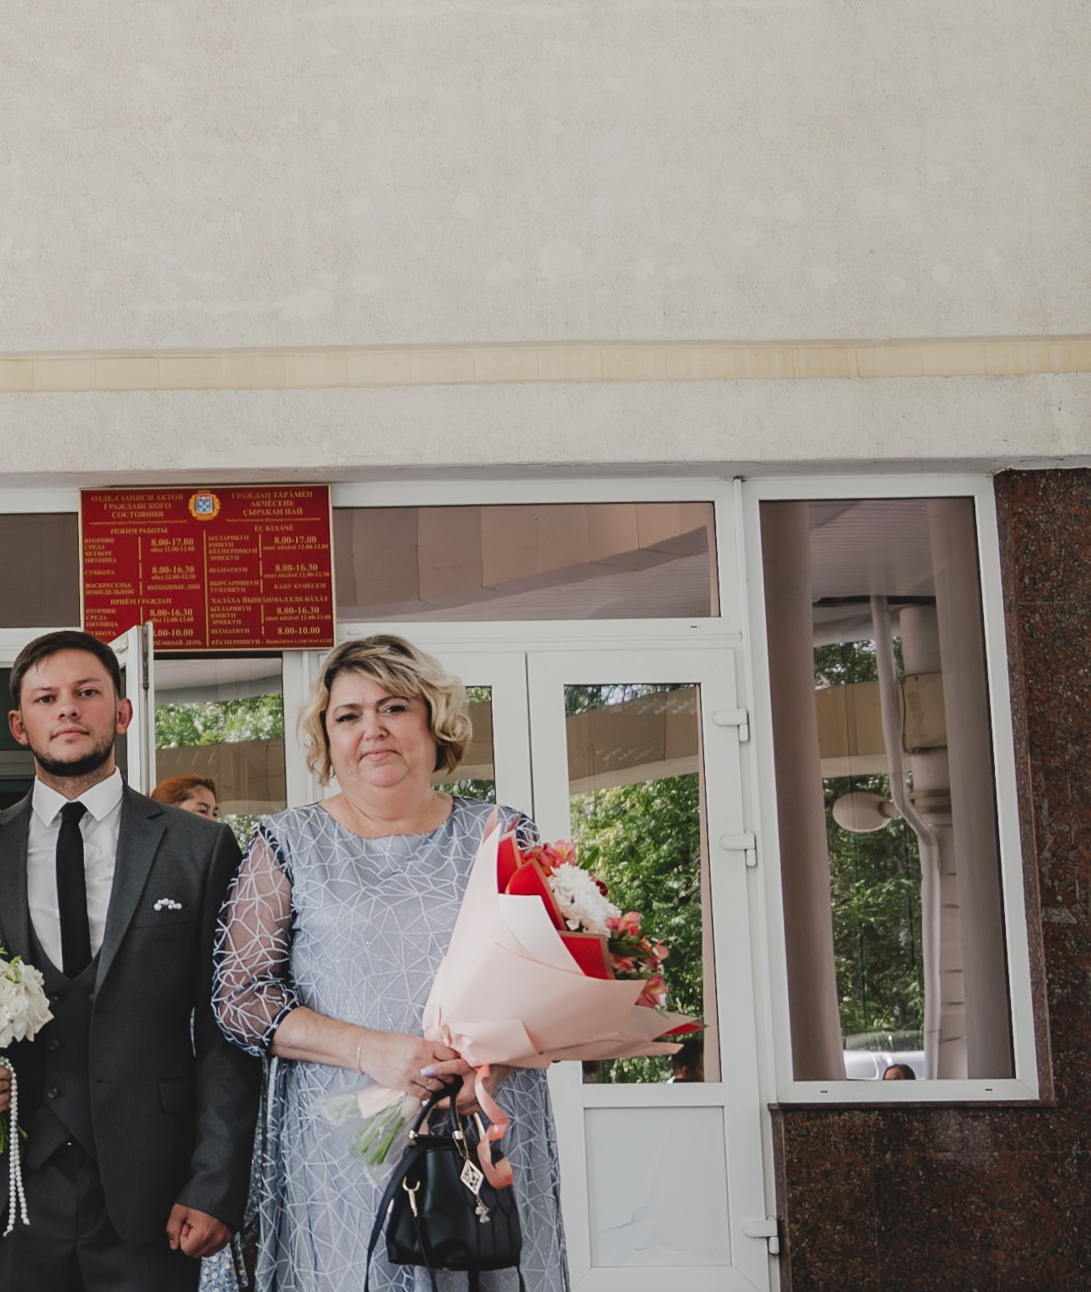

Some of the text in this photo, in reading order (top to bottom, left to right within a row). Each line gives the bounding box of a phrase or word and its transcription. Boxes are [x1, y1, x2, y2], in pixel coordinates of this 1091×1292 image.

[103, 502, 171, 510] ГРАЖДАНСКОГО
[111, 511, 164, 519] СОСТОЯНИЯ
[150, 538, 194, 546] 8.00-17.00
[274, 536, 317, 544] 8.00-17.00
[152, 566, 195, 574] 8.00-16.30
[275, 564, 318, 572] 8.00-16.30
[150, 608, 193, 616] 8.00-16.30
[276, 606, 320, 615] 8.00-16.30
[277, 627, 320, 635] 8.00-10.00
